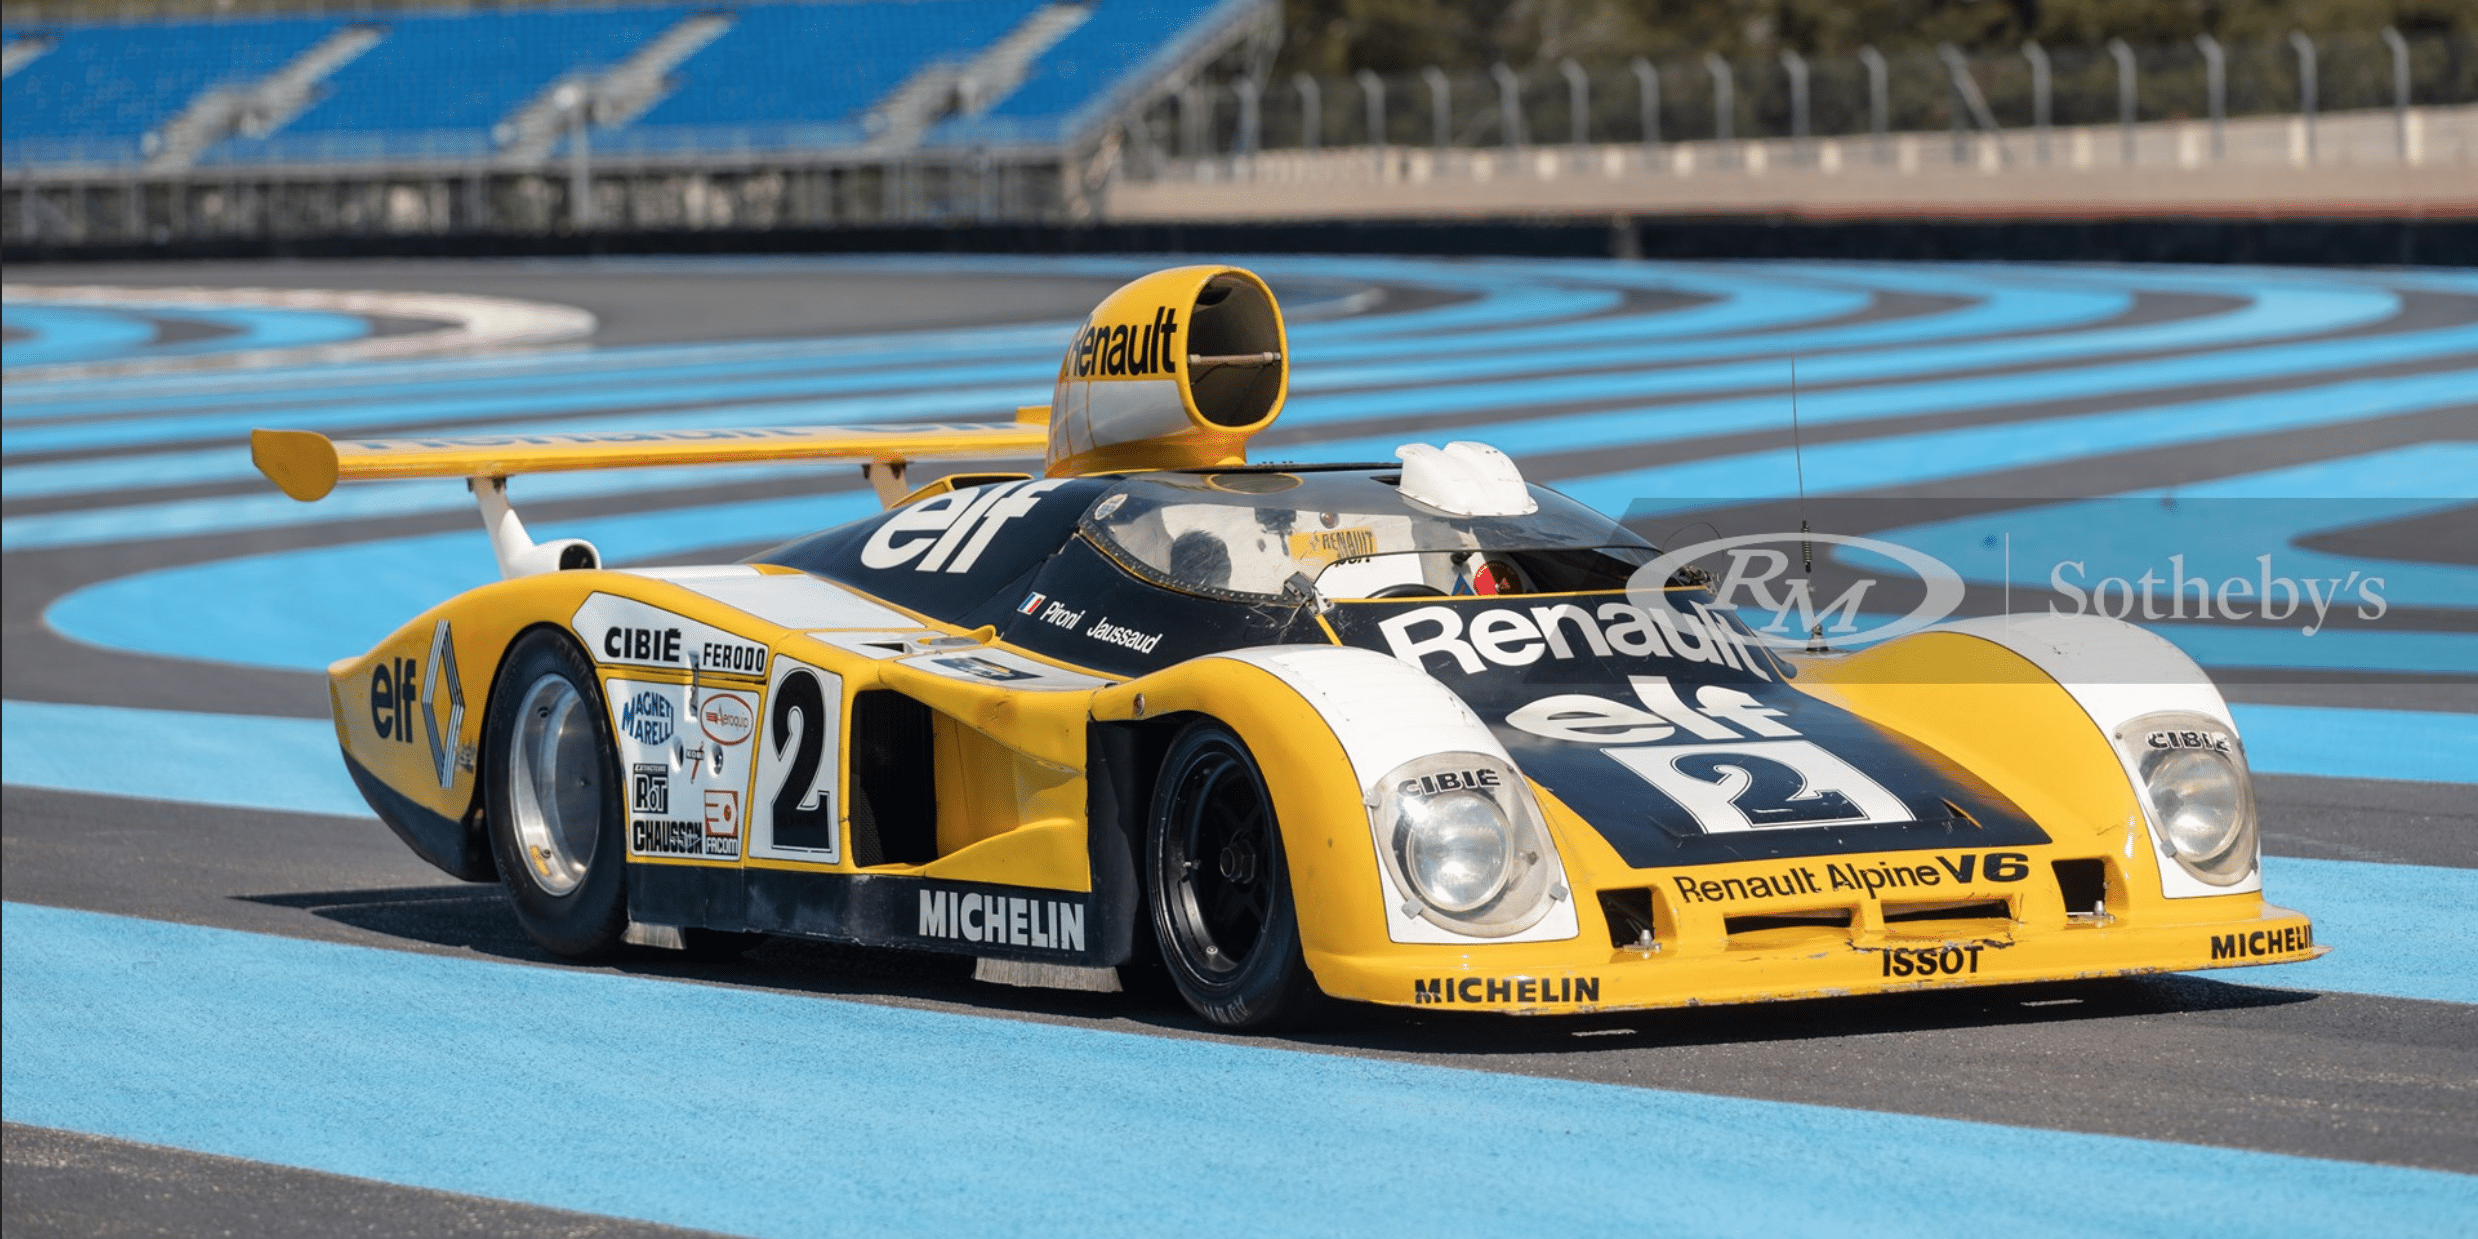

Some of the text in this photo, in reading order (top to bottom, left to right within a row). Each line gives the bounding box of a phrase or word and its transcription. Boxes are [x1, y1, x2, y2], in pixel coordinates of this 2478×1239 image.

[861, 476, 1078, 573] elf
[604, 626, 681, 663] CIBIÉ
[1040, 600, 1163, 654] Pironi Jaussaud
[1378, 600, 1773, 682] Renault
[703, 642, 766, 673] FERODO
[371, 656, 417, 744] elf
[1505, 675, 1803, 743] elf
[771, 667, 833, 854] 2
[1670, 751, 1871, 829] 2
[633, 820, 702, 855] CHAUSSON
[1674, 852, 2030, 904] Renault Alpine V6
[919, 888, 1086, 952] MICHELIN
[1414, 976, 1600, 1005] MICHELIN
[1882, 945, 1984, 978] ISSOT
